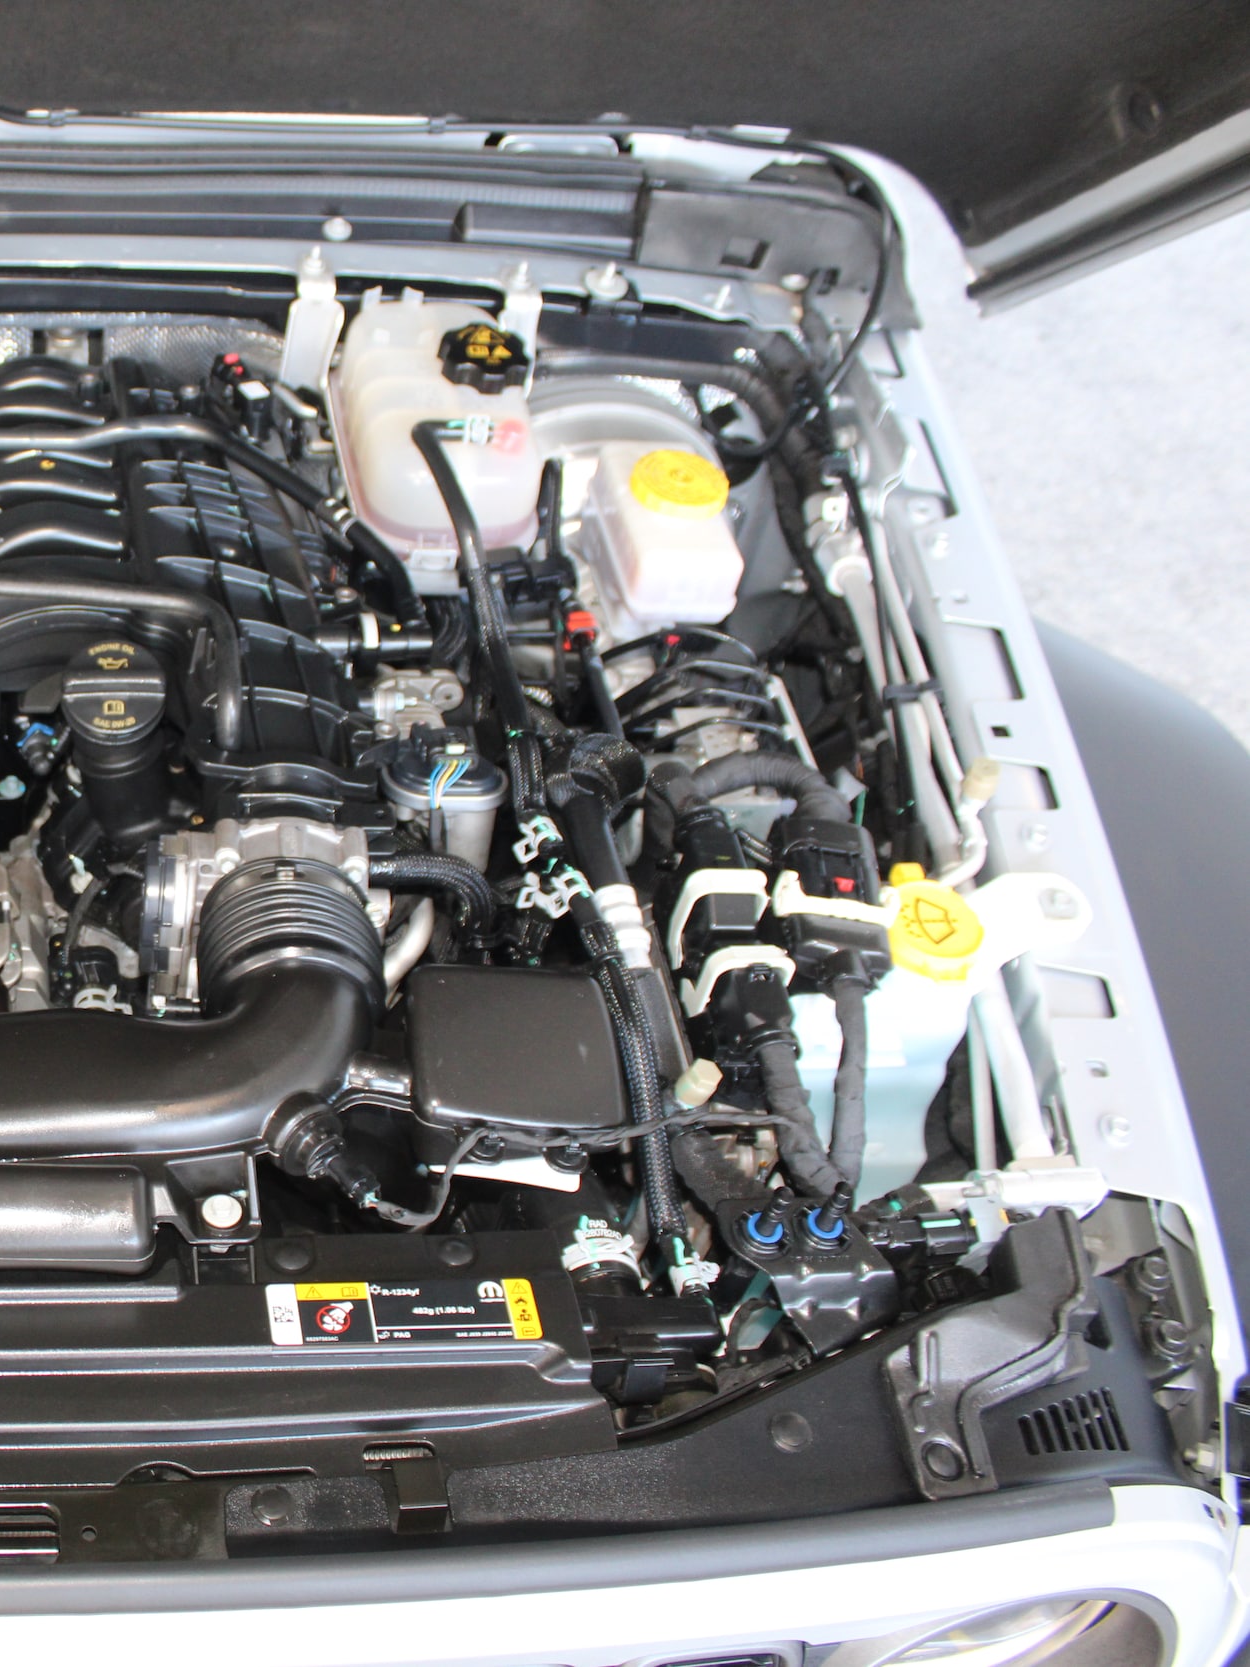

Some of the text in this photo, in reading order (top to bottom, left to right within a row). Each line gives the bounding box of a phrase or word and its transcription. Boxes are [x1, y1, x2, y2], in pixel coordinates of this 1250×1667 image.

[88, 642, 135, 656] ENGINE OIL
[93, 716, 111, 729] SAE
[588, 1219, 608, 1229] RAD
[381, 1287, 420, 1297] R-1234yf
